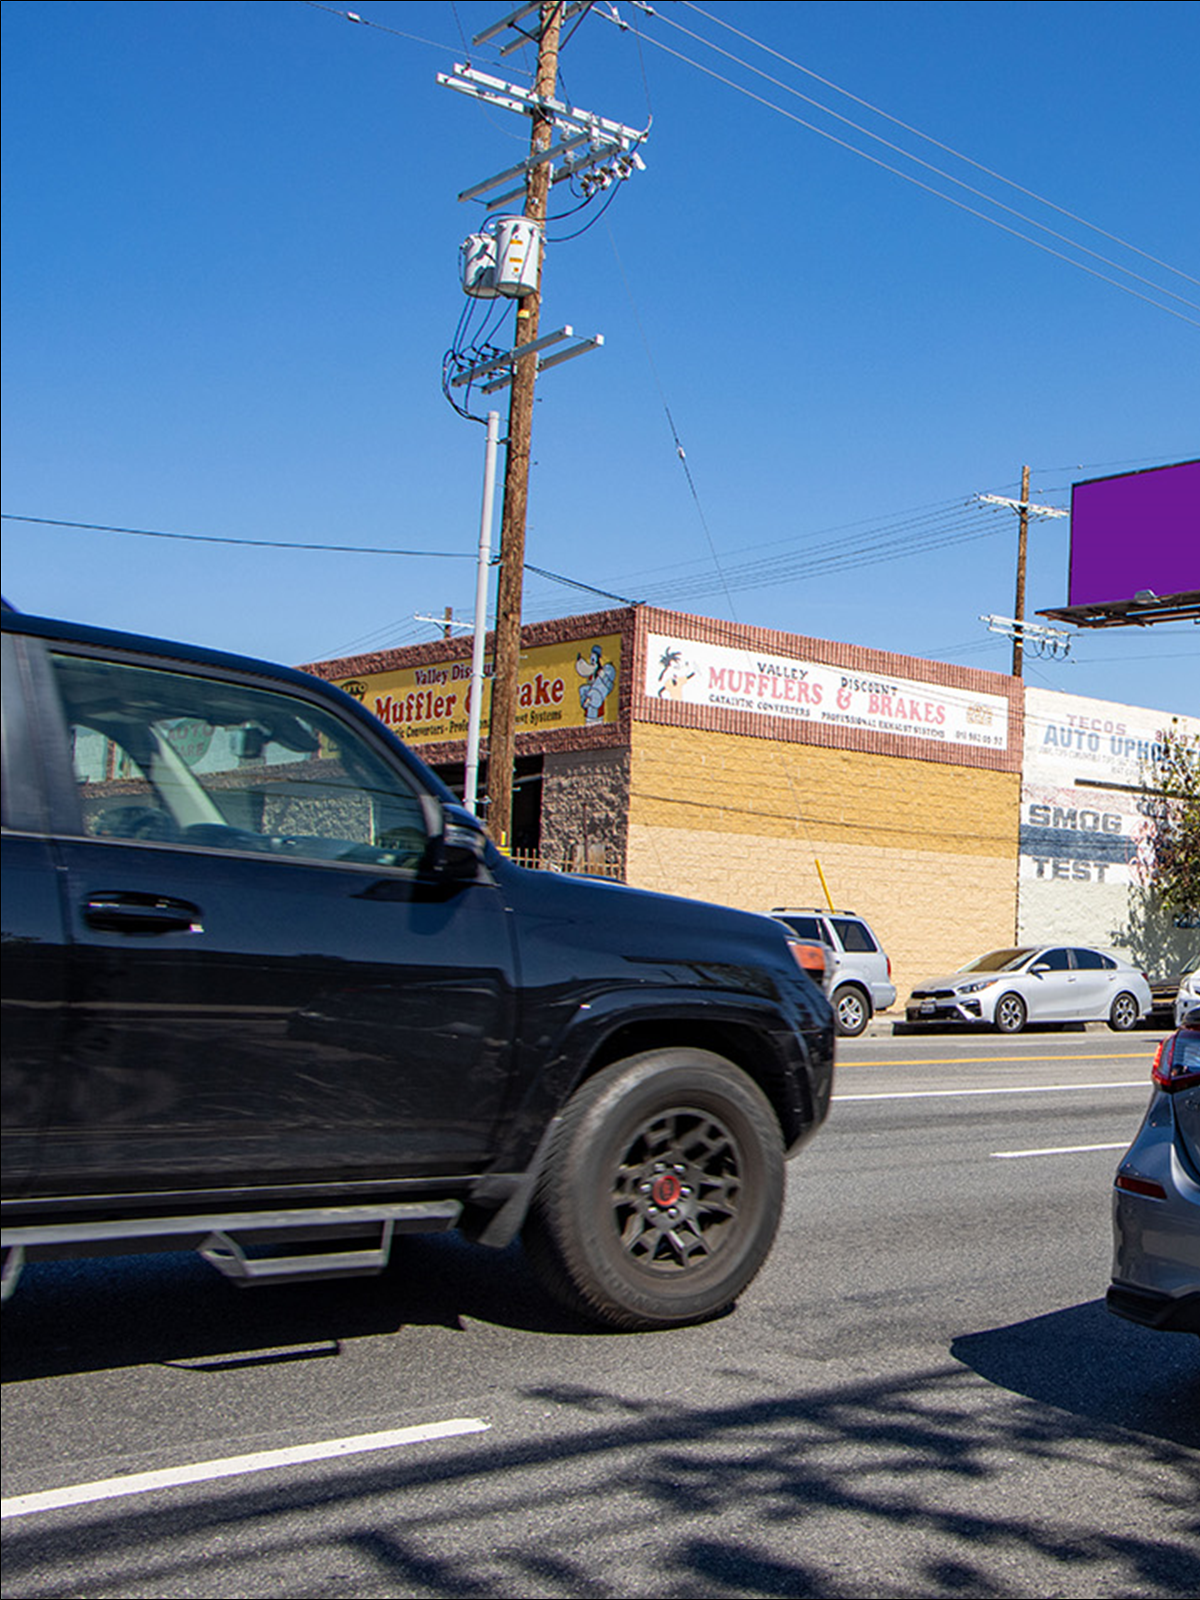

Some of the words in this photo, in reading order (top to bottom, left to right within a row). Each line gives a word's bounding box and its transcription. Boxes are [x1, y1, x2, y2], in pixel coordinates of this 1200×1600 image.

[415, 667, 448, 686] Valley
[757, 661, 808, 680] VALLEY
[841, 677, 898, 696] DISCOUNT
[375, 689, 457, 725] Muffler
[516, 673, 565, 708] ake
[708, 666, 823, 705] MUFFLERS
[836, 687, 852, 710] &
[867, 694, 946, 725] BRAKES
[708, 694, 754, 709] CATALYTIC
[757, 701, 811, 717] CONVERTERS
[530, 710, 562, 726] Systems
[1066, 714, 1127, 735] TECOS
[1043, 724, 1101, 753] AUTO
[1028, 803, 1123, 835] SMOG
[1032, 856, 1110, 883] TEST
